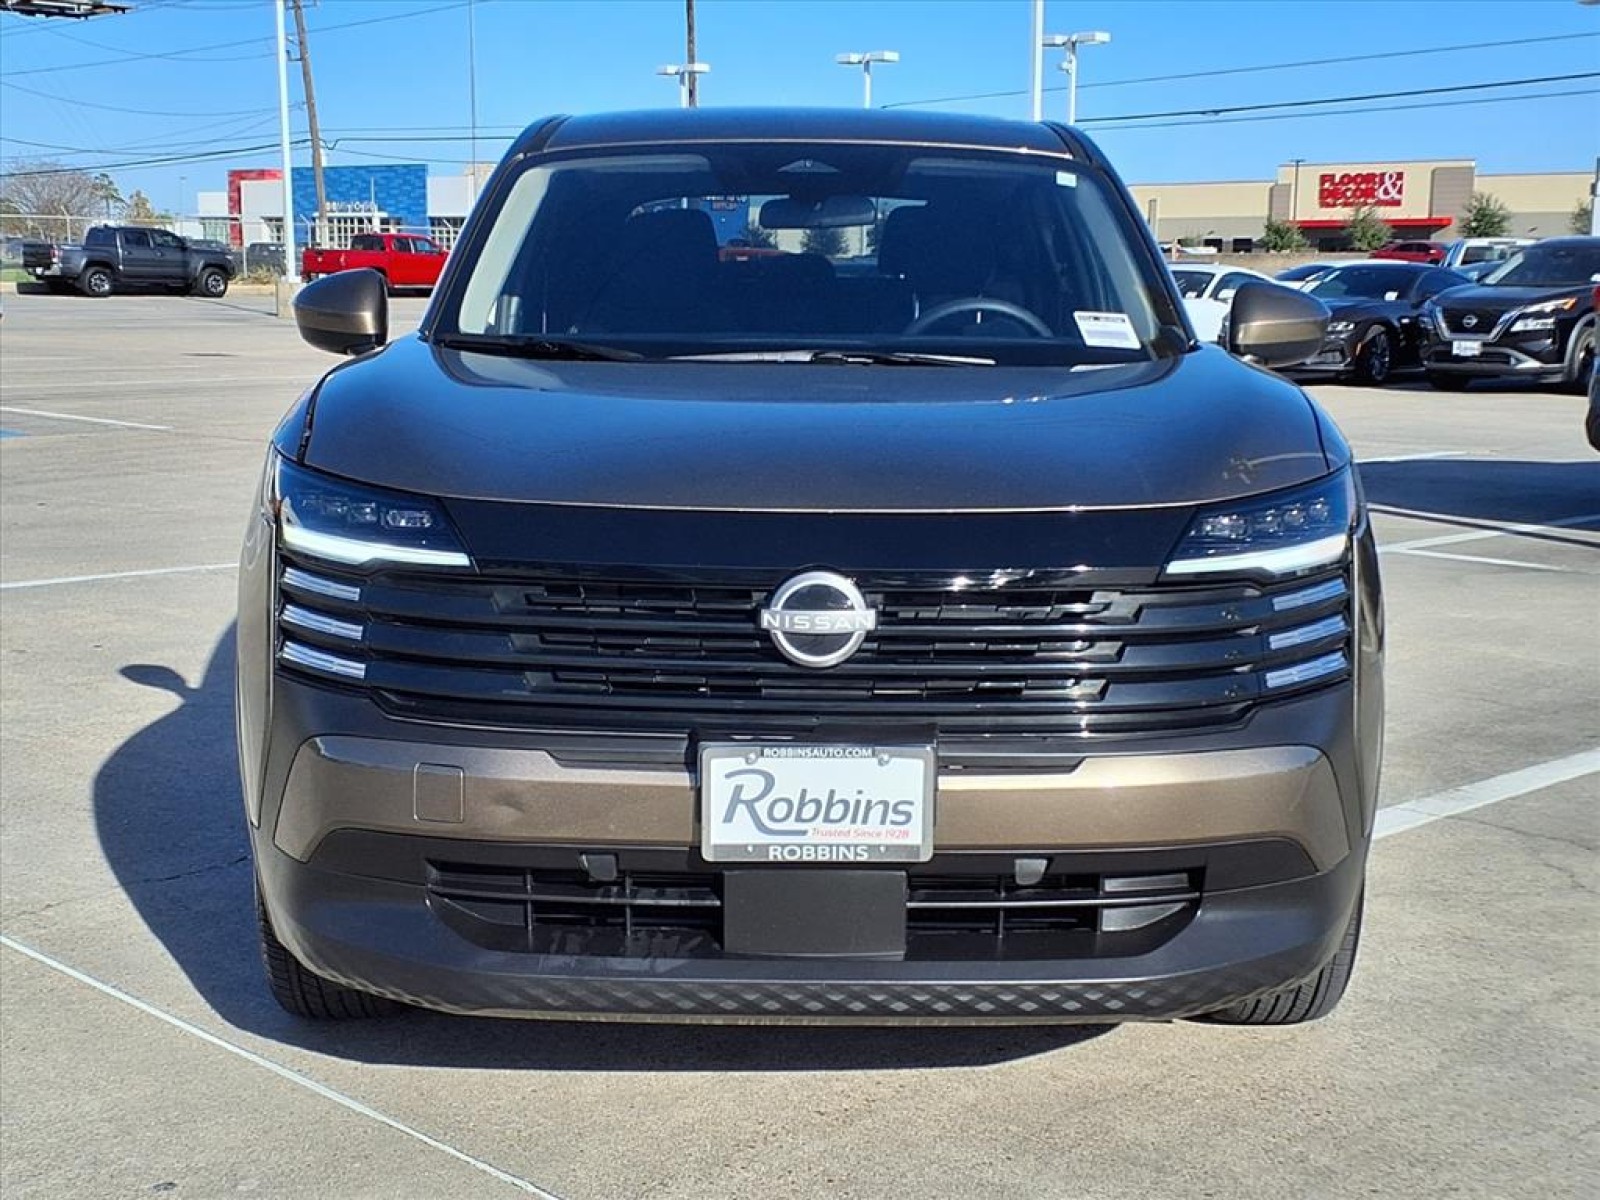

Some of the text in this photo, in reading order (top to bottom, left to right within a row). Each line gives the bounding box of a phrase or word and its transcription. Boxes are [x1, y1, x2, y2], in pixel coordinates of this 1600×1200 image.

[763, 613, 872, 630] NISSAN
[763, 747, 873, 758] ROBBINSAUTO.COM
[722, 768, 915, 836] Robbins
[812, 828, 910, 839] Trusted Since 1928
[768, 845, 870, 861] ROBBINS
